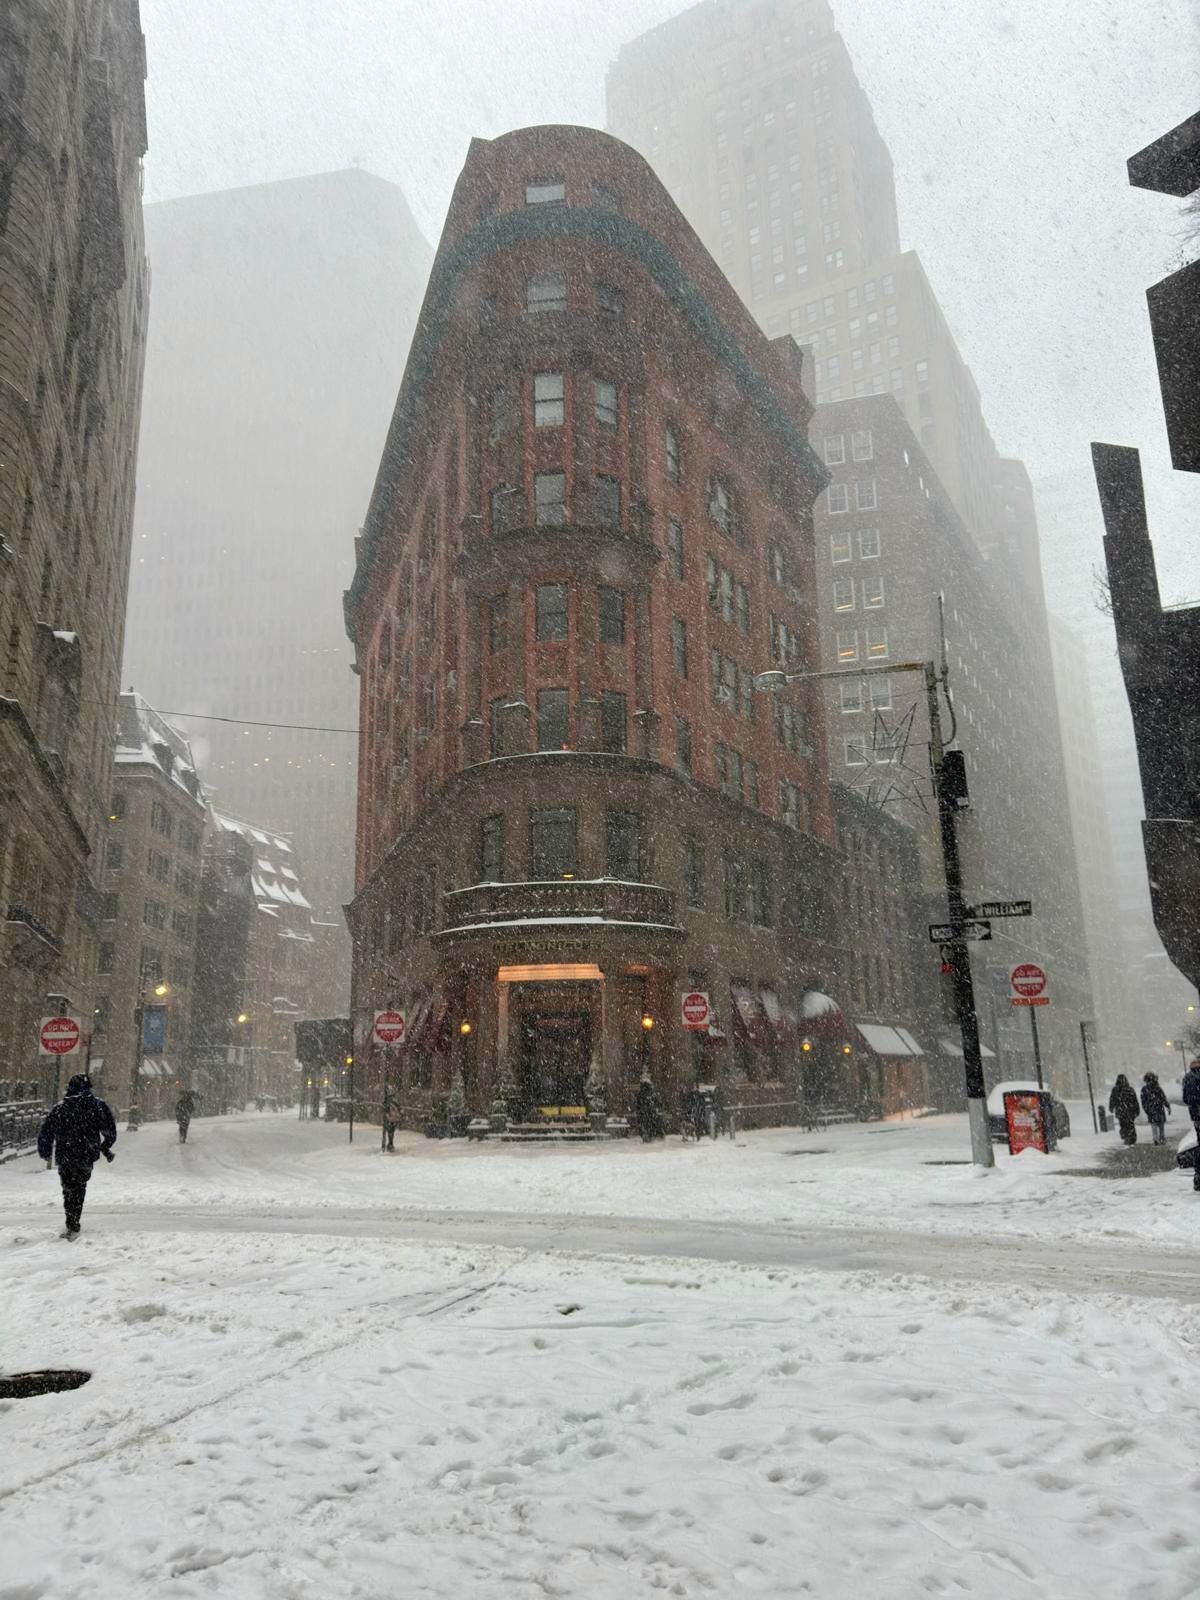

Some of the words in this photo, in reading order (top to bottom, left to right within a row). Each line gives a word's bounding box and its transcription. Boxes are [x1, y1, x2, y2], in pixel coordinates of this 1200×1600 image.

[984, 904, 1023, 916] WILLIAM
[60, 1023, 73, 1031] NOT
[48, 1040, 74, 1048] ENTER
